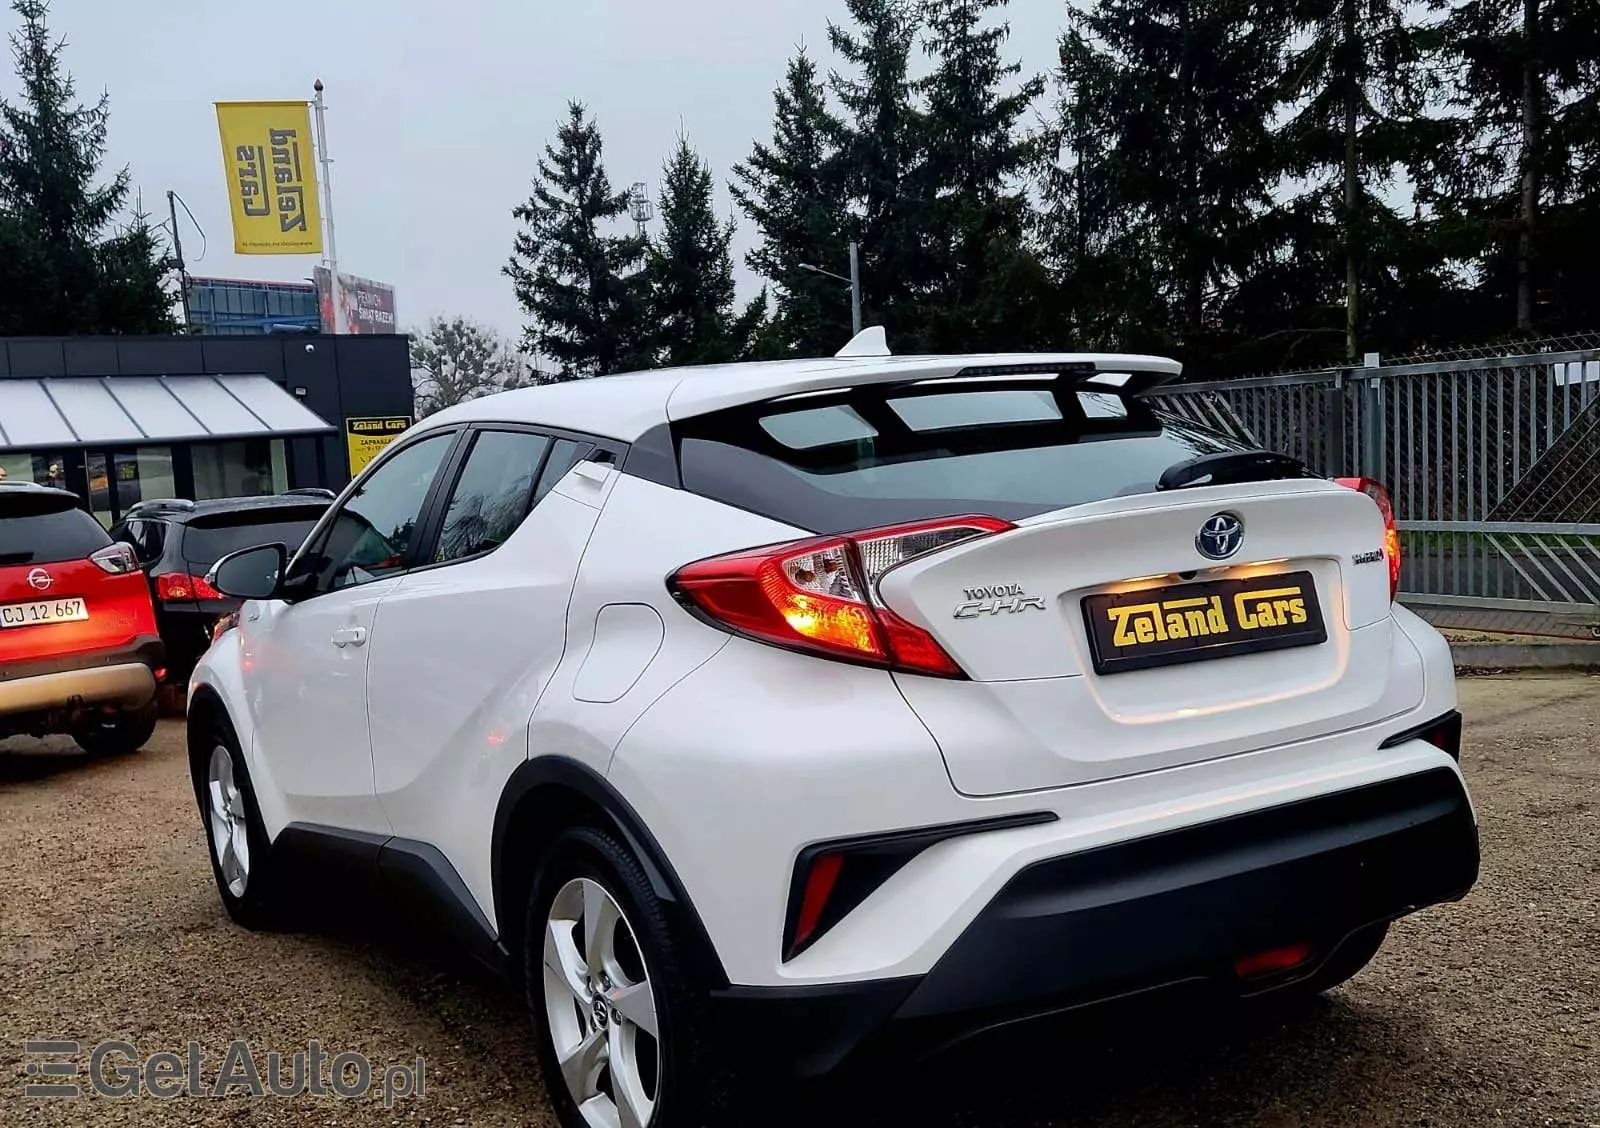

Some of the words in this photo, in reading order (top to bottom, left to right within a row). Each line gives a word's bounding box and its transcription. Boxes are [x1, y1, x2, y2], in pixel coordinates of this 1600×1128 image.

[353, 421, 384, 430] Zeland
[385, 420, 406, 429] Cars
[963, 584, 1024, 601] TOYOTA
[2, 607, 25, 623] CJ
[30, 604, 50, 620] 12
[55, 601, 81, 617] 667
[953, 597, 1046, 620] C-HR
[1107, 595, 1229, 647] Zeland
[1233, 586, 1307, 630] Cars
